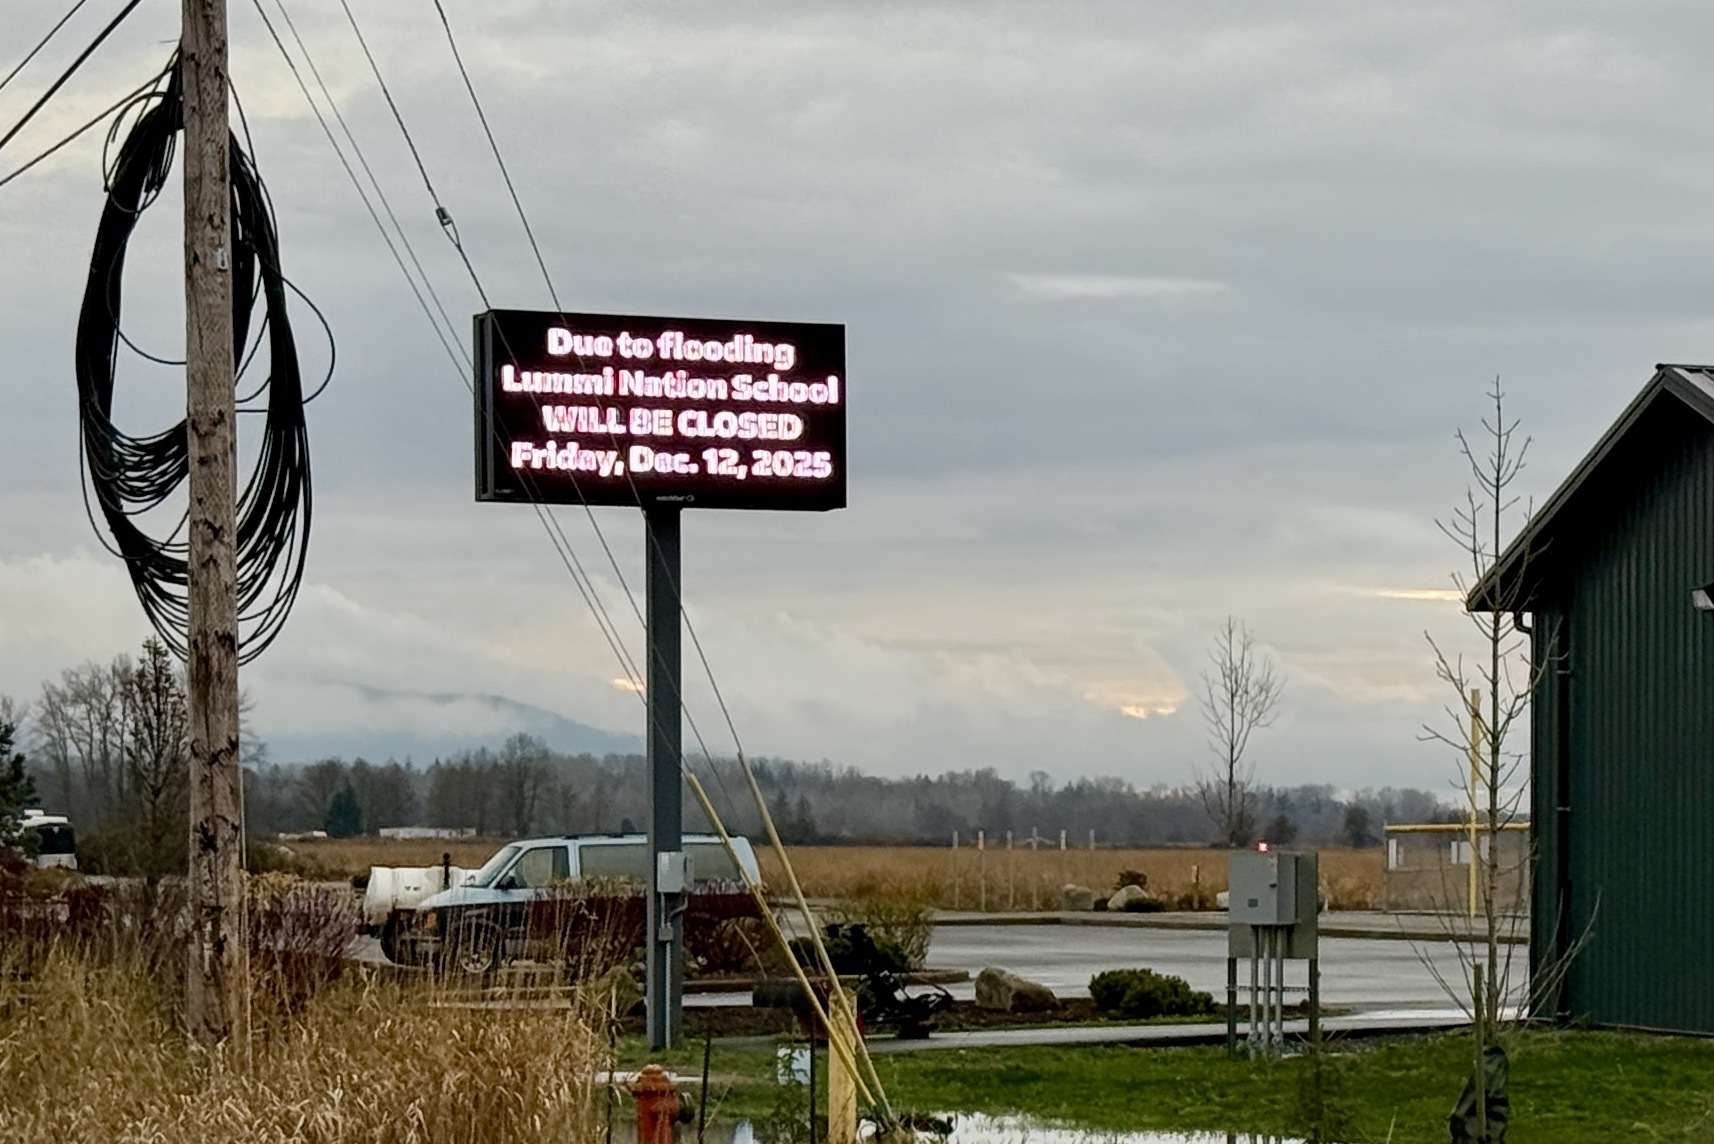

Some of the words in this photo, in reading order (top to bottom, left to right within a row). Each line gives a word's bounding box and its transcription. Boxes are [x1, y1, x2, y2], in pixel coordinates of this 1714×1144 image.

[548, 328, 613, 357] Due
[616, 332, 653, 358] to
[658, 332, 795, 370] flooding
[502, 365, 614, 394] Lummi
[619, 371, 728, 399] Nation
[732, 375, 838, 404] School
[543, 405, 626, 433] WILL
[630, 408, 673, 436] BE
[678, 410, 803, 440] CLOSED
[512, 441, 624, 477] Friday,
[630, 446, 698, 473] Dec.
[703, 449, 747, 479] 12,
[753, 450, 832, 478] 2025
